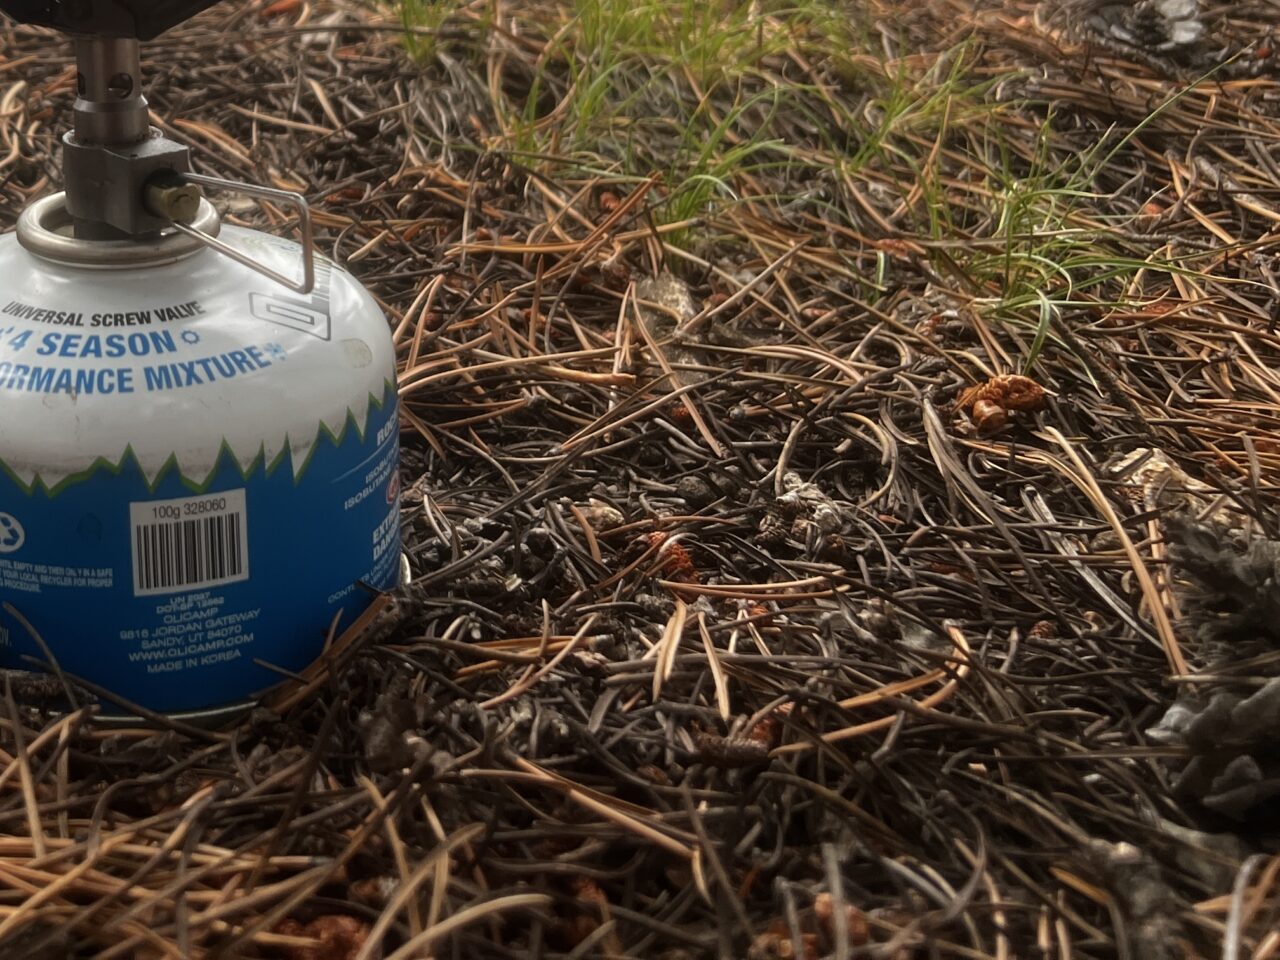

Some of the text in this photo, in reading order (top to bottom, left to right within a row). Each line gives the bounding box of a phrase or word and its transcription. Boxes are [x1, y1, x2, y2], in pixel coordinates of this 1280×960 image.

[1, 300, 206, 327] UNIVERSAL SCREW VALVE
[37, 329, 179, 358] SEASON
[144, 343, 273, 391] MIXTURE
[152, 497, 226, 519] 100g 328060
[3, 568, 19, 579] YOUR
[20, 571, 39, 583] LOCAL
[40, 574, 72, 586] RECYCLER
[73, 577, 86, 586] FOR
[87, 577, 113, 588] PROPER
[13, 560, 33, 572] EMPTY
[34, 564, 47, 574] AND
[97, 568, 113, 577] SAFE
[152, 622, 202, 637] JORDAN
[205, 608, 261, 629] GATEWAY
[163, 607, 218, 624] OLICAMP
[188, 632, 204, 643] UT
[207, 624, 242, 640] 84070
[147, 649, 242, 673] MADE IN KOREA
